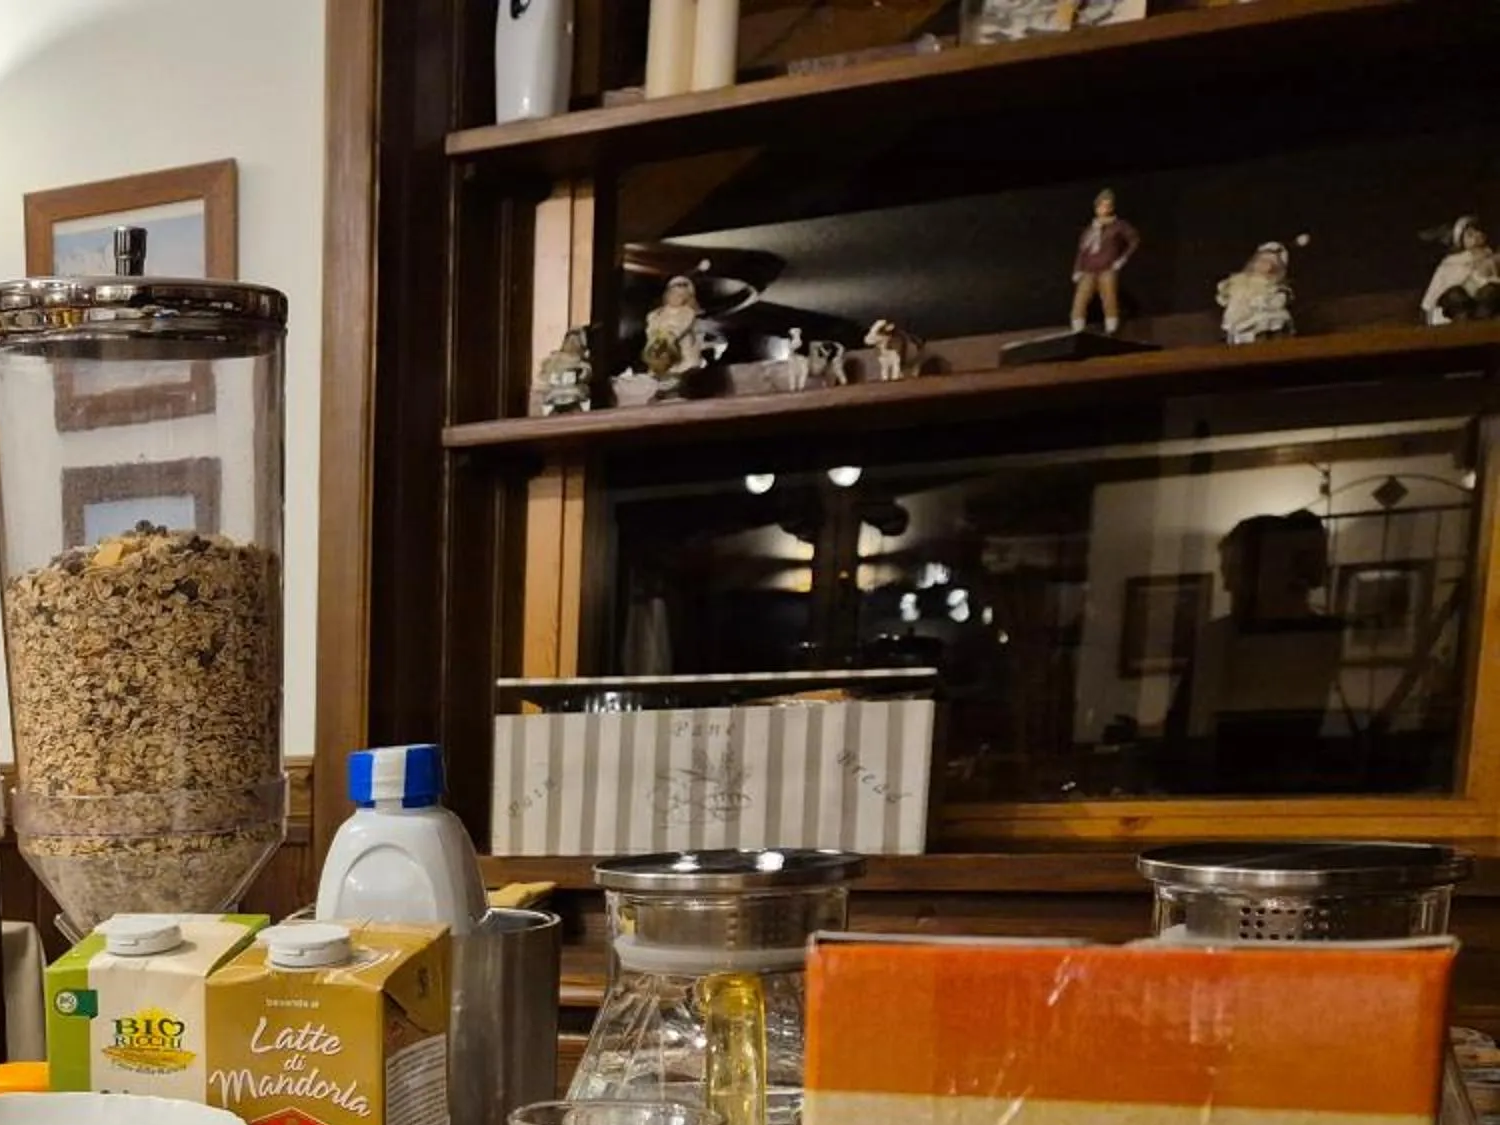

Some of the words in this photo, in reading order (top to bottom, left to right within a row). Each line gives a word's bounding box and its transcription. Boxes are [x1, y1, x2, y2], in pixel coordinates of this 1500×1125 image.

[112, 1017, 186, 1037] BIO
[251, 1016, 343, 1056] Latte
[284, 1053, 308, 1072] di
[209, 1068, 372, 1118] Mandorla
